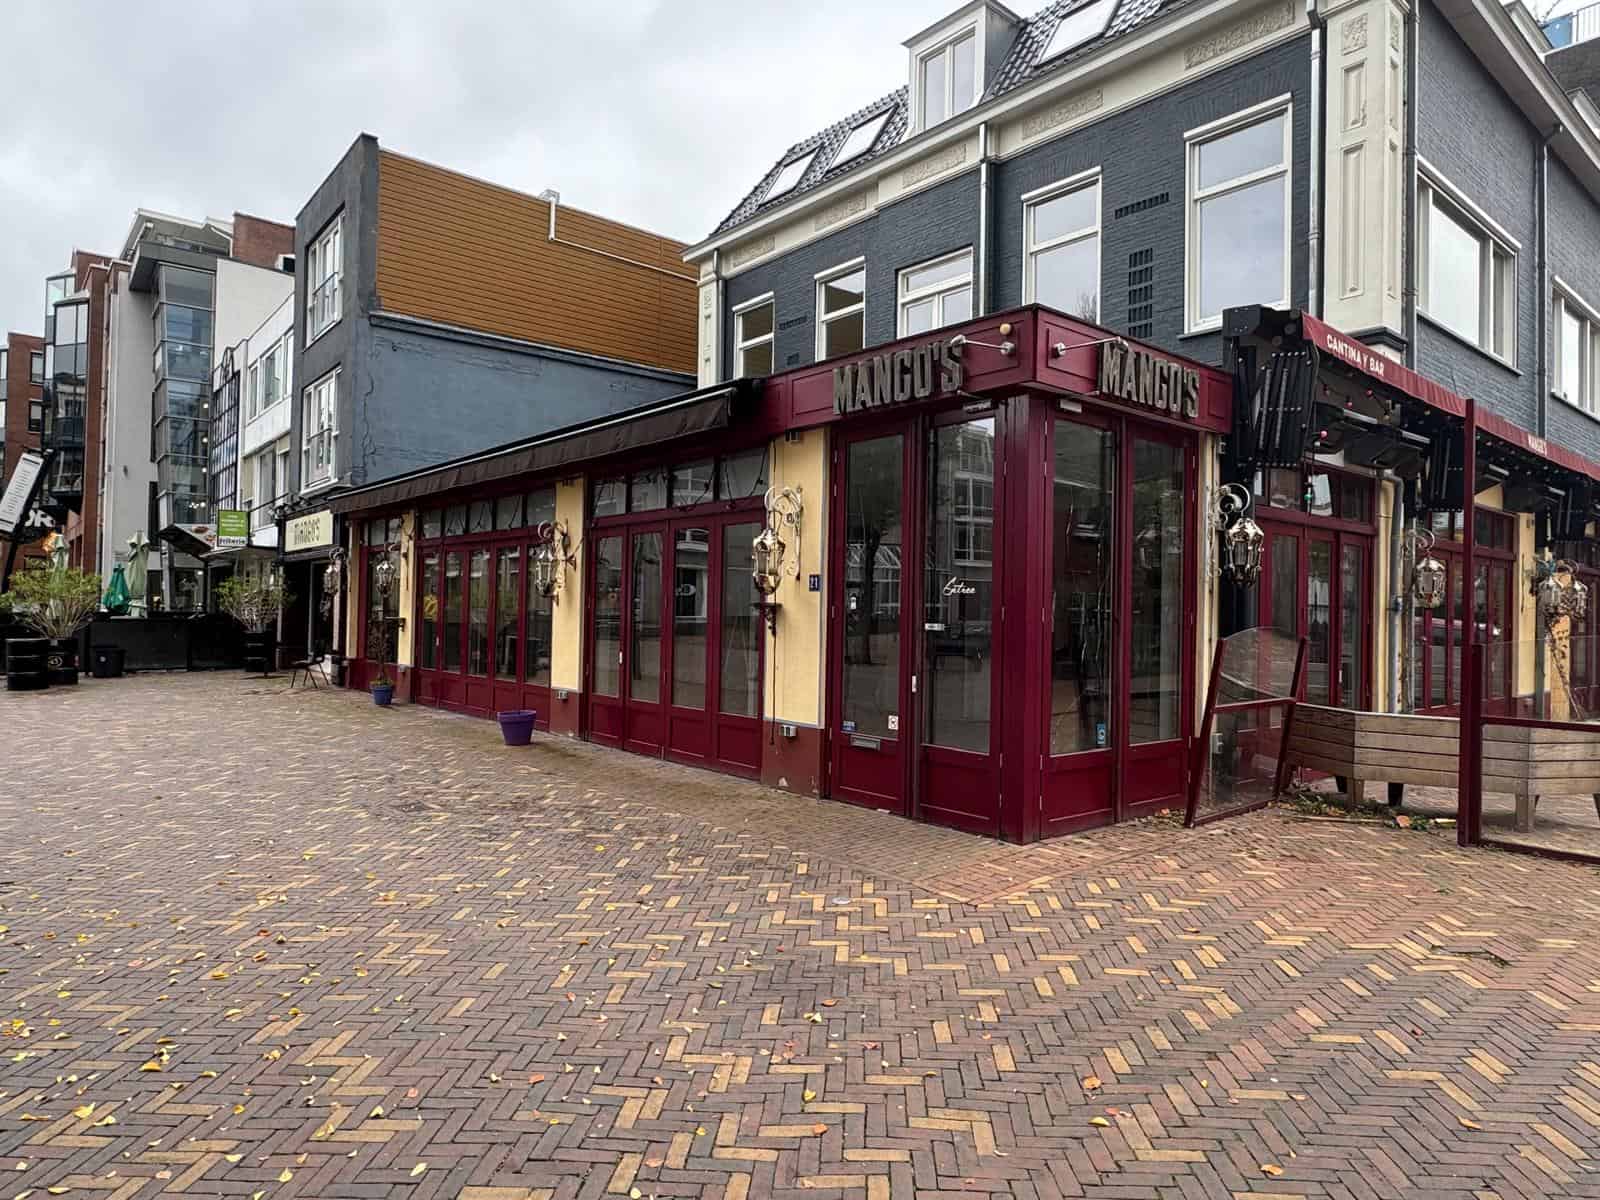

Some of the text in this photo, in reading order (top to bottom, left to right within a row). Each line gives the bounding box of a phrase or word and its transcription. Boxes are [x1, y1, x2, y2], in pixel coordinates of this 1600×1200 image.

[832, 339, 964, 415] MANGO'S
[1101, 340, 1200, 418] MANGO'S
[1326, 334, 1385, 377] CANTINA Y BAR
